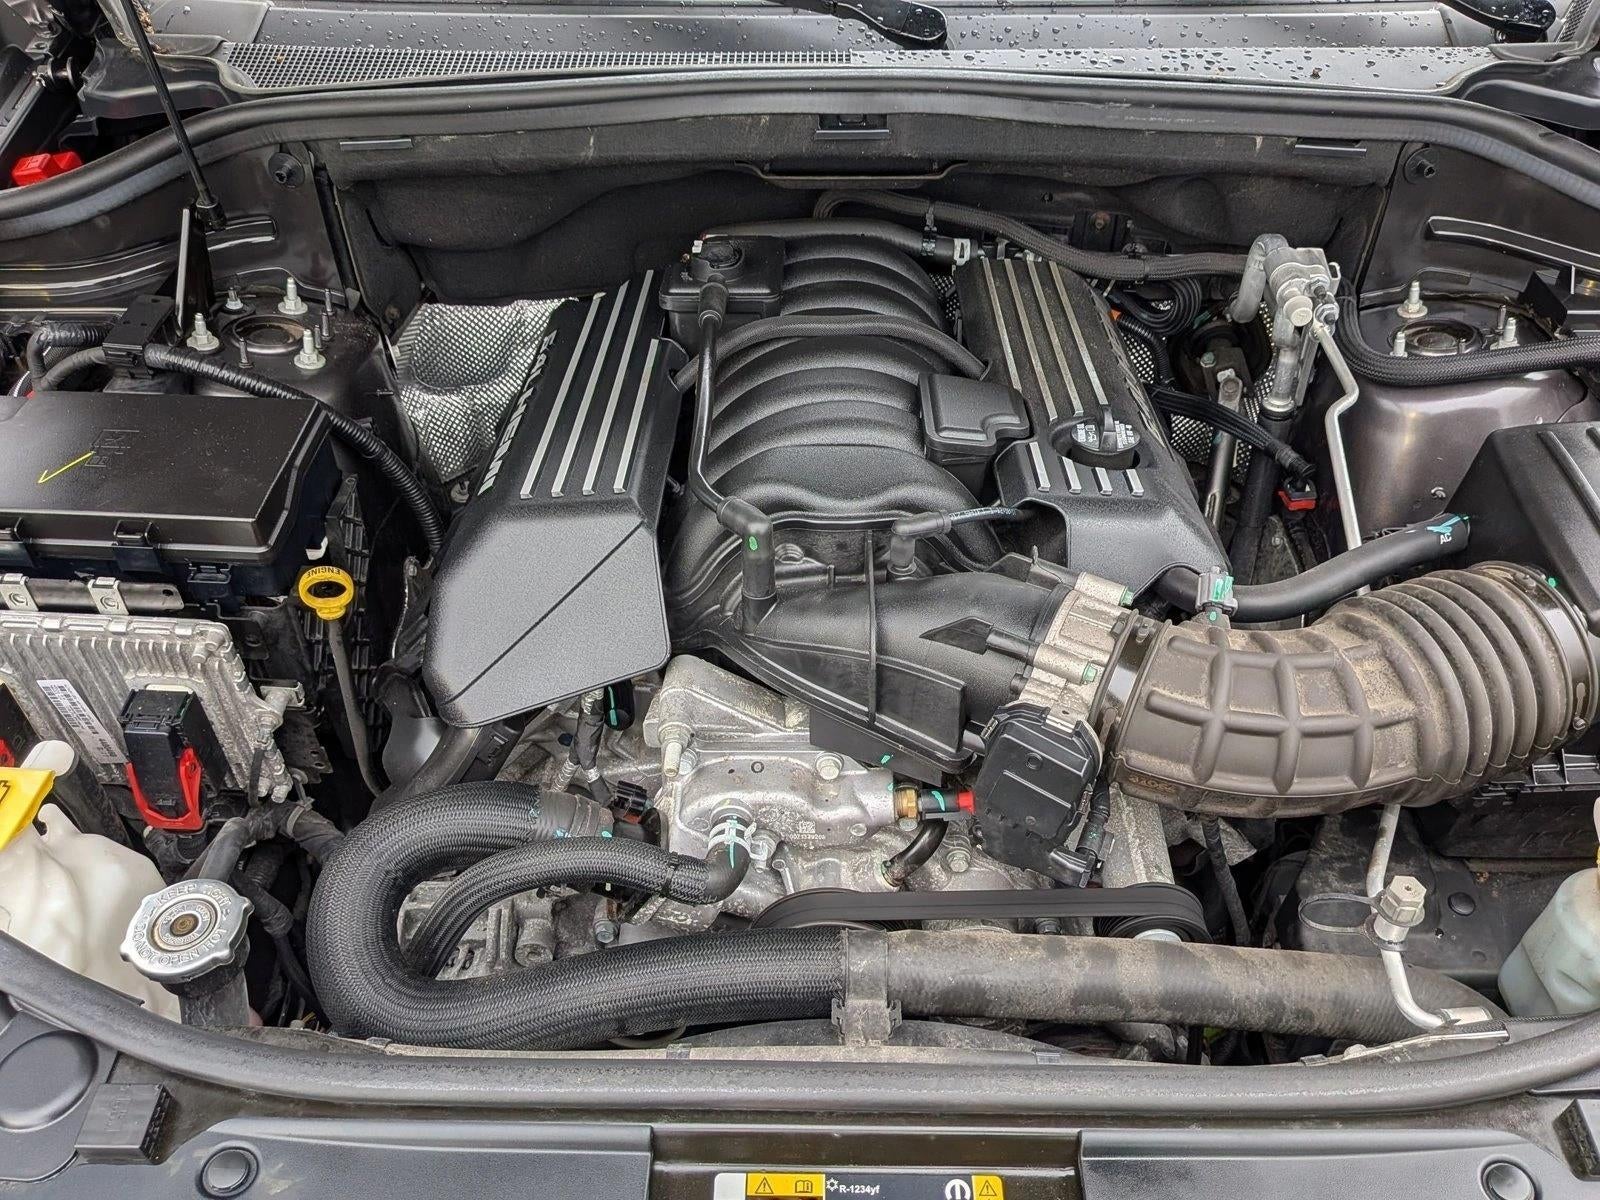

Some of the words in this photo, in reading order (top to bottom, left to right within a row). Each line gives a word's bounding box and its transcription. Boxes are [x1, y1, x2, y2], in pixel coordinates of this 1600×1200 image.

[477, 386, 535, 497] HEMI
[1440, 532, 1452, 545] AC
[306, 567, 341, 578] ENGINE
[159, 948, 201, 966] OPEN
[201, 927, 228, 954] HOT
[839, 1184, 880, 1195] R-1234yf
